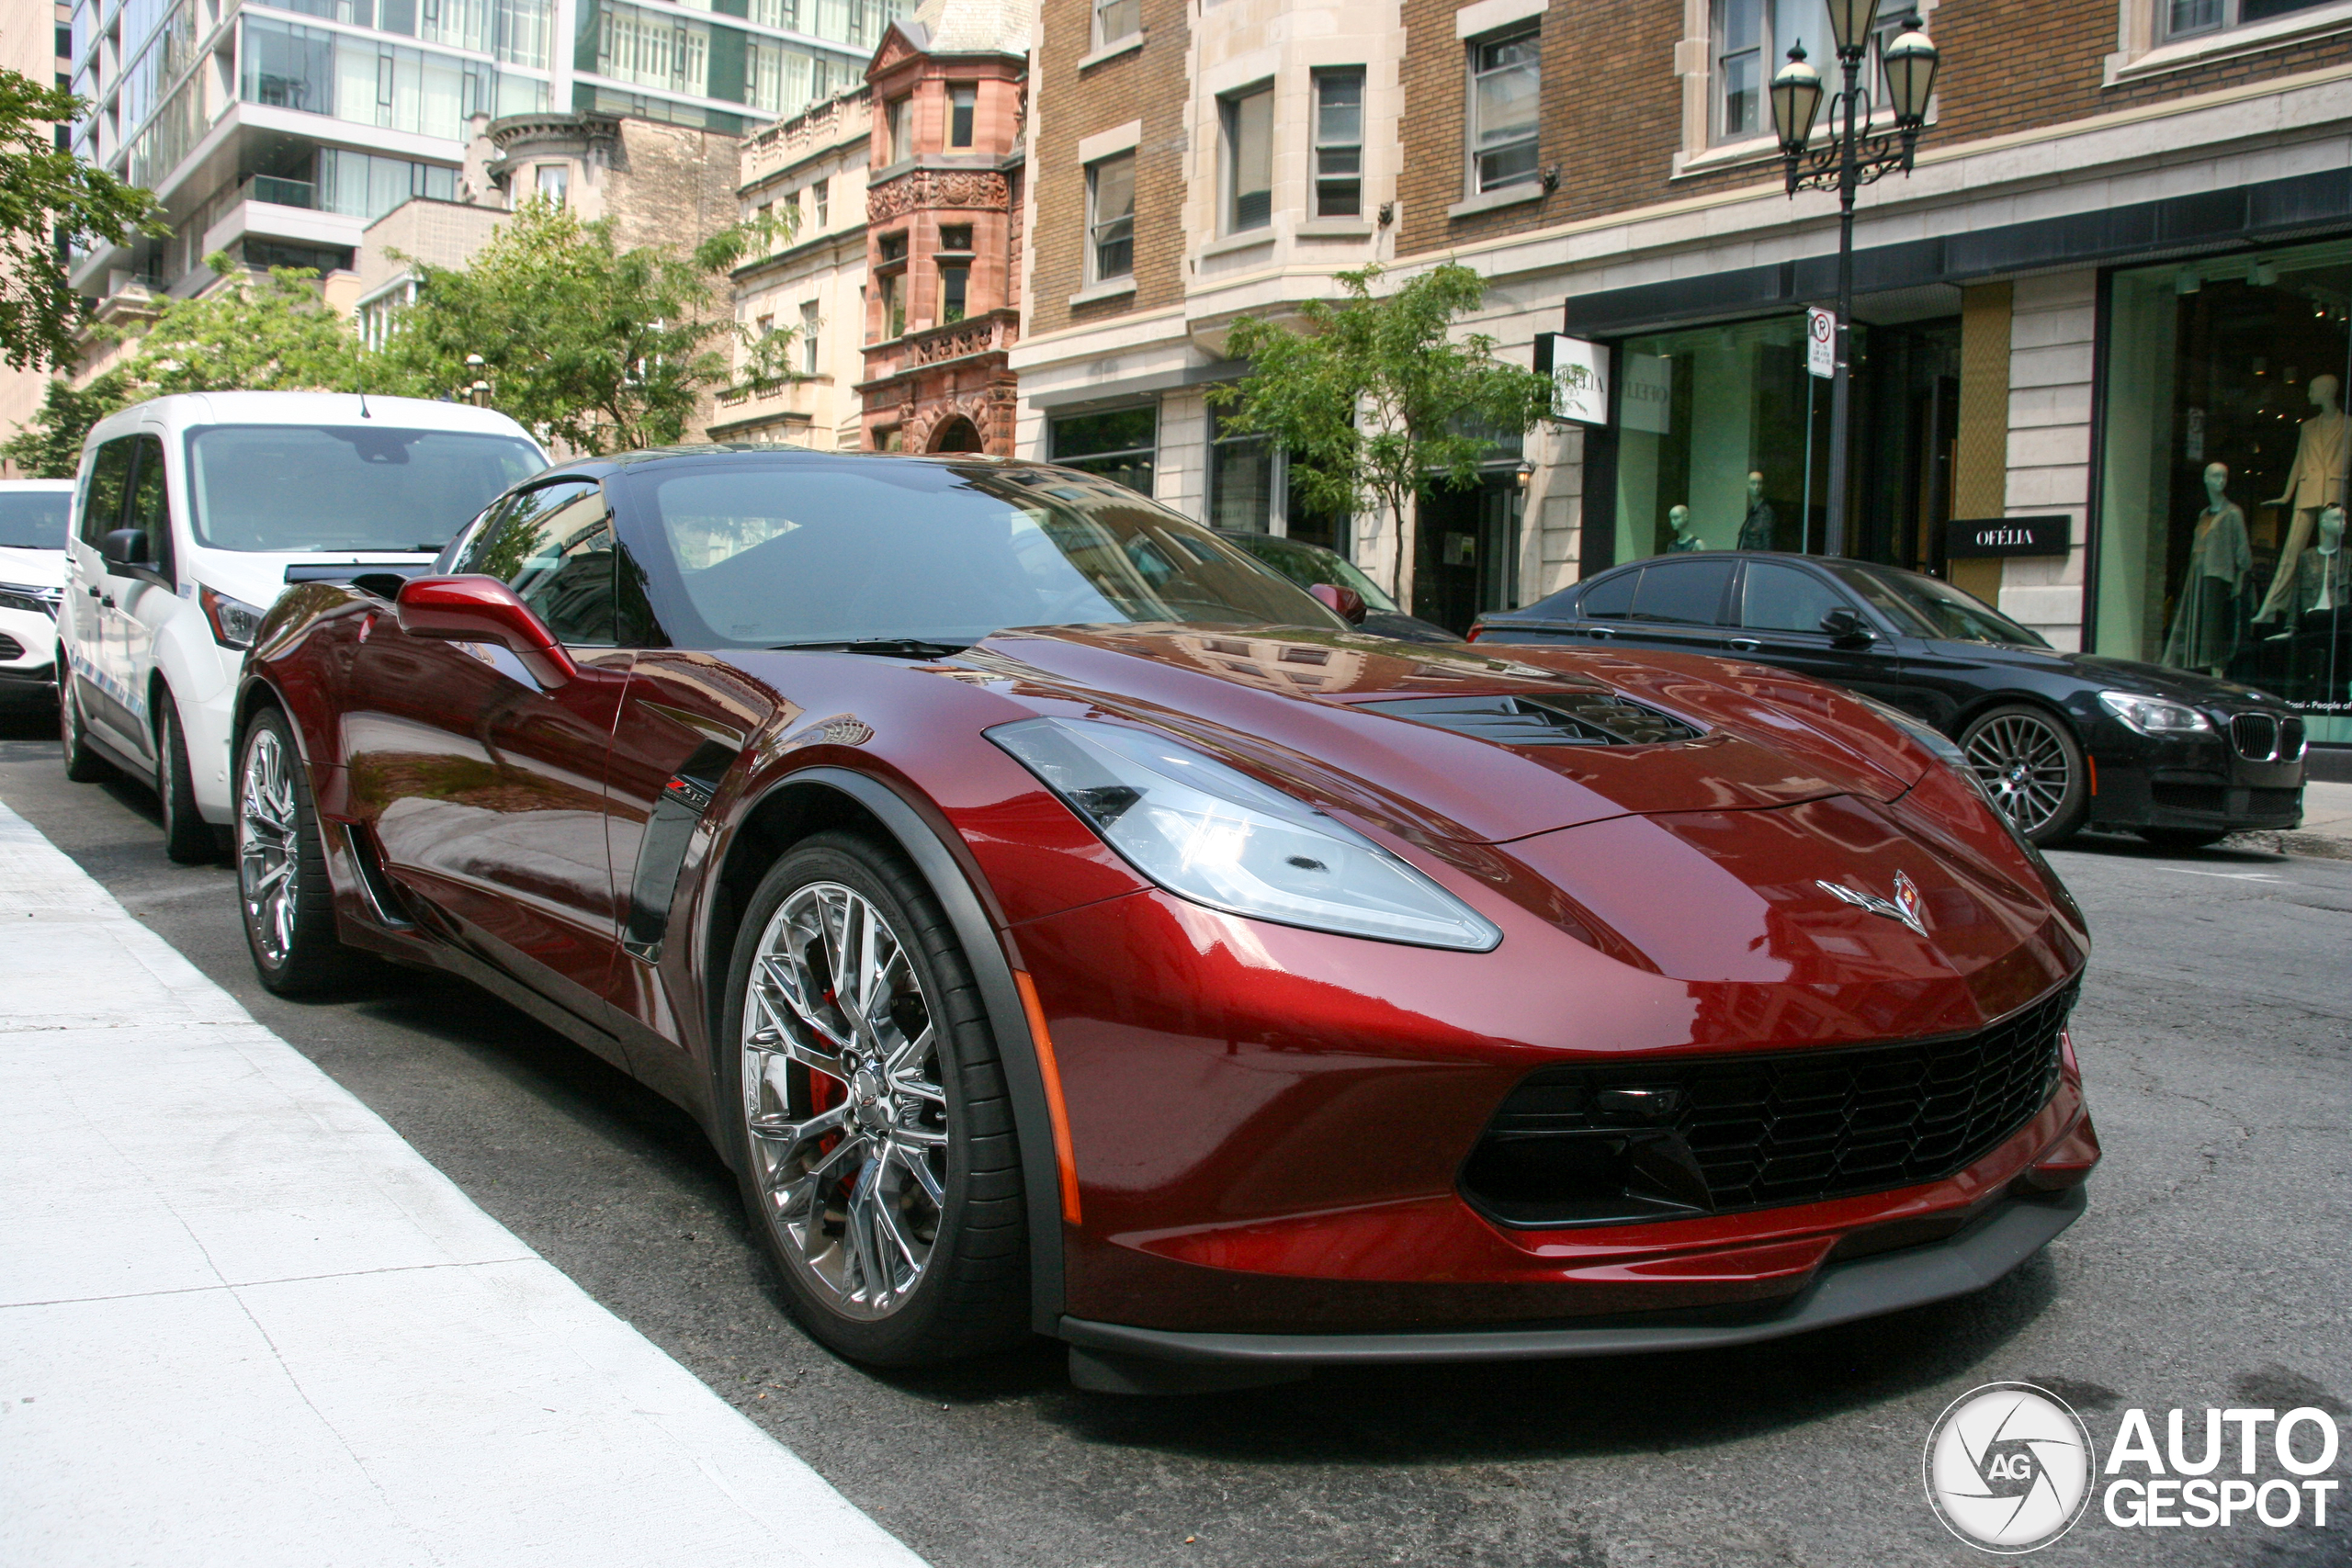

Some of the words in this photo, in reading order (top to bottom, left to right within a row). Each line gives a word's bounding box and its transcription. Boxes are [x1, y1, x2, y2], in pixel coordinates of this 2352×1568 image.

[1976, 525, 2033, 546] OFÉLIA
[2312, 700, 2341, 712] People
[2342, 700, 2352, 710] of
